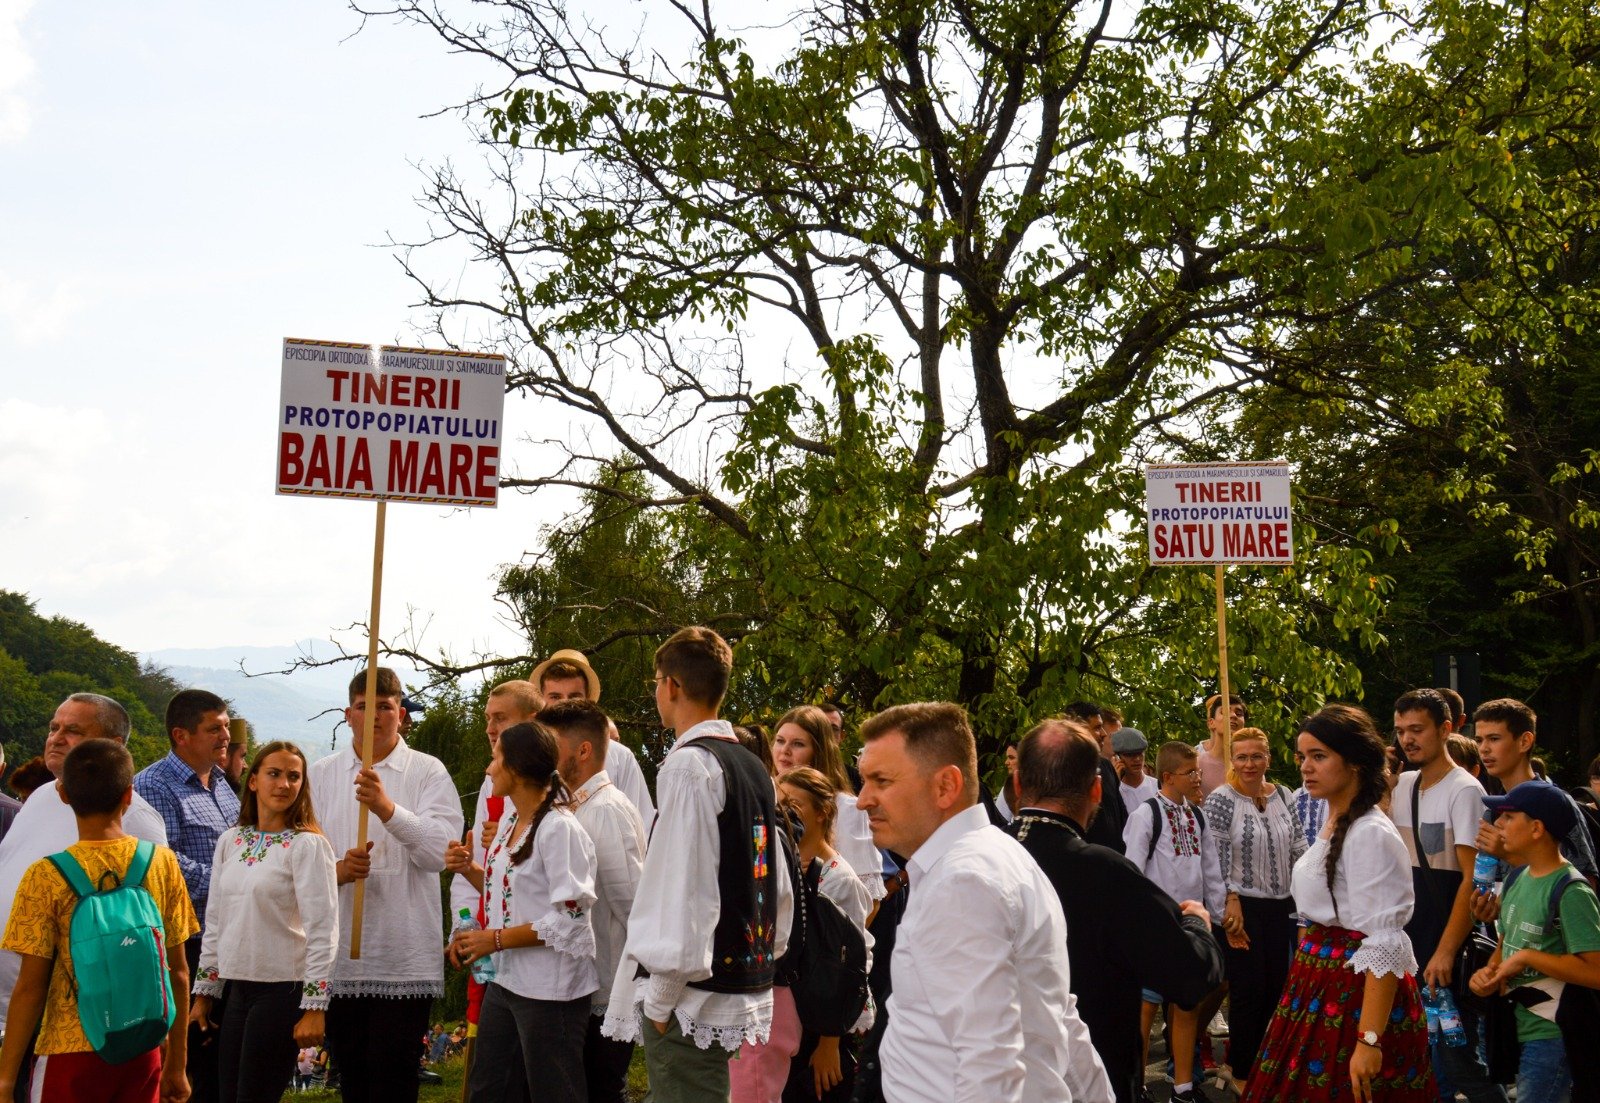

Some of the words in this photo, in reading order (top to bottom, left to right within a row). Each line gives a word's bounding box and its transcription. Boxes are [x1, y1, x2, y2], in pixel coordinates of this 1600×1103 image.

[285, 347, 326, 362] EPISCOPIA
[327, 369, 461, 410] TINERII
[284, 405, 497, 439] PROTOPOPIATULUI
[279, 431, 373, 491] BAIA
[387, 439, 498, 498] MARE
[1175, 481, 1261, 503] TINERII
[1152, 506, 1288, 521] PROTOPOPIATULUI
[1154, 523, 1214, 559] SATU
[1222, 523, 1289, 557] MARE
